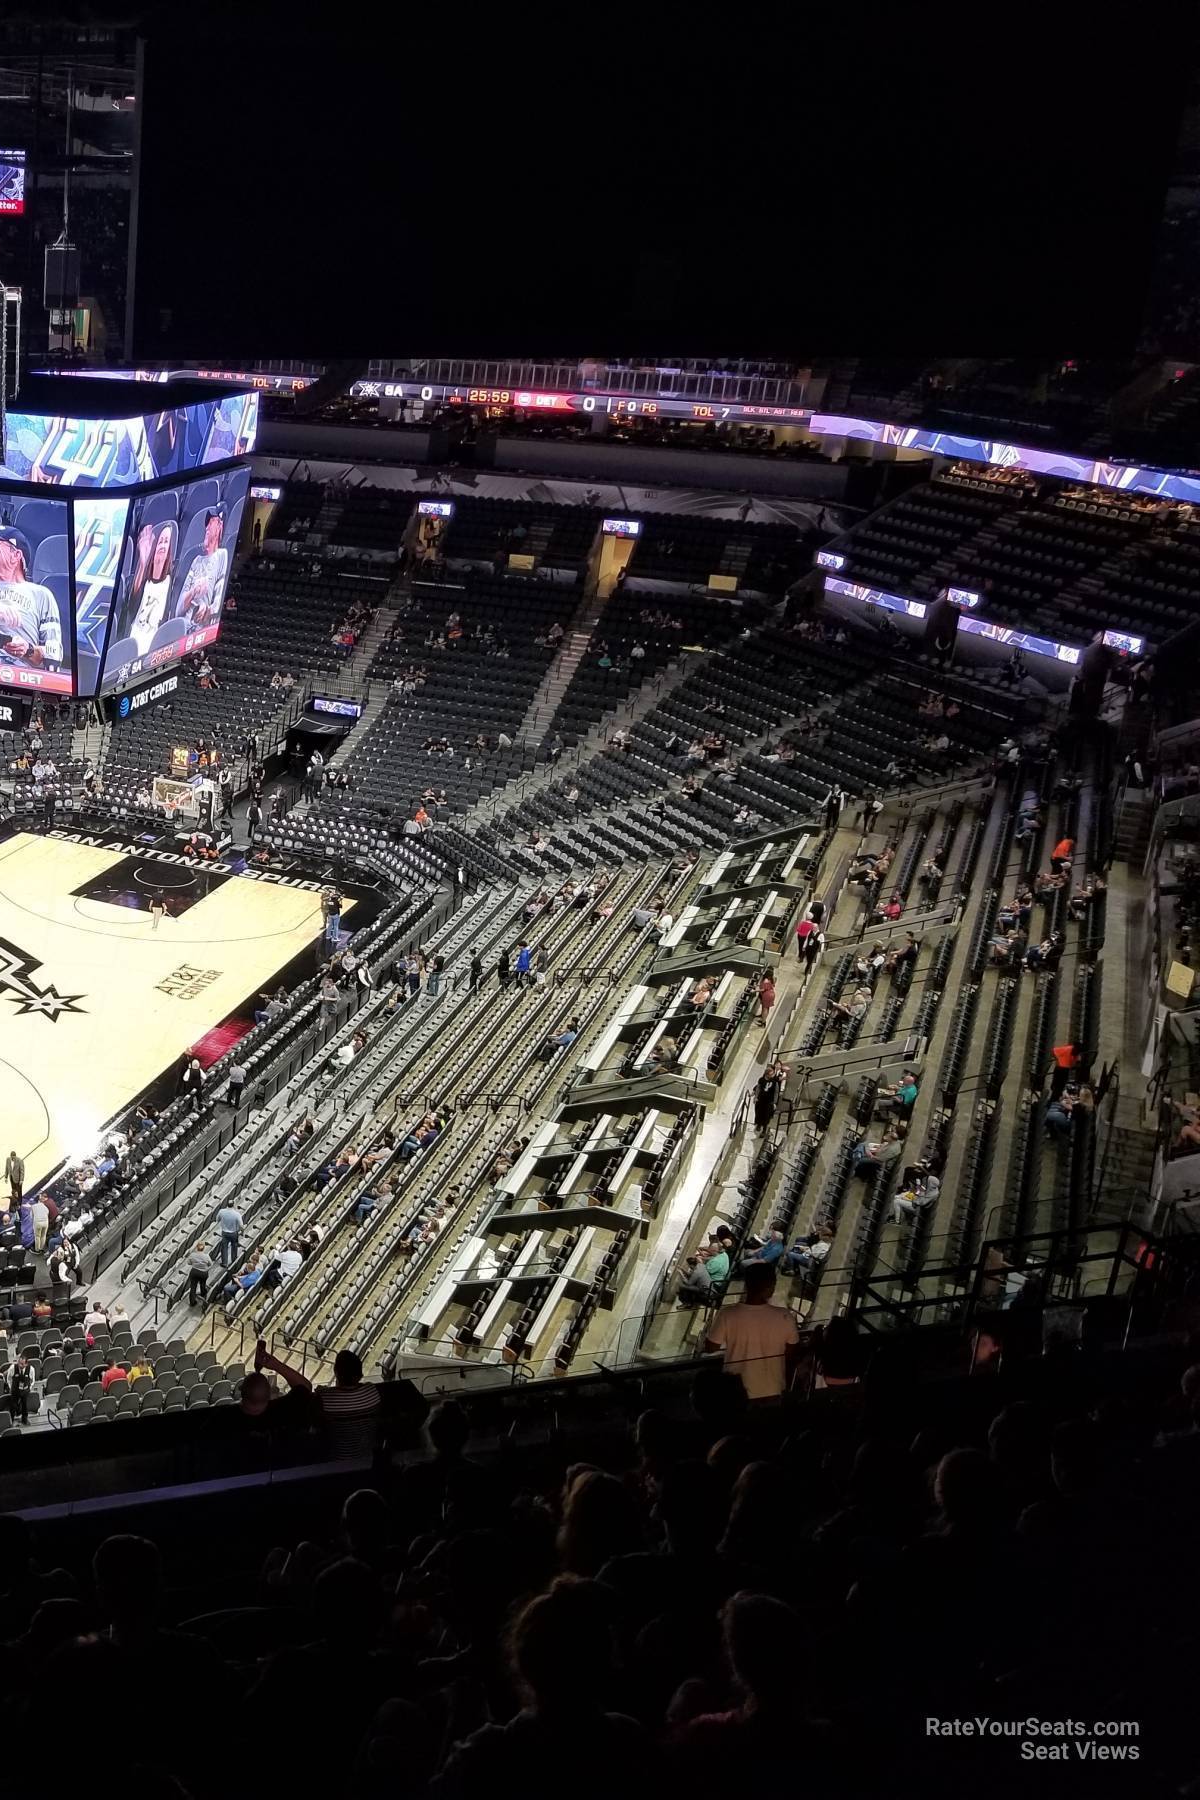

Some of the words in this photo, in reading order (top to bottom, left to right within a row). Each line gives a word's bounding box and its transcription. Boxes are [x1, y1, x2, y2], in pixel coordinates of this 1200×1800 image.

[252, 377, 269, 387] TOL
[275, 379, 282, 388] 7
[292, 380, 304, 390] FG
[384, 385, 402, 397] SA
[421, 387, 432, 400] 0
[453, 388, 459, 396] 1
[469, 391, 510, 403] 25:59
[536, 396, 559, 406] DET
[583, 397, 595, 411] 0
[618, 402, 626, 411] F
[627, 402, 636, 411] 0
[642, 403, 657, 412] FG
[693, 406, 714, 417] TOL
[722, 408, 730, 418] 7
[195, 632, 207, 645] DET
[151, 645, 174, 665] 25:59
[131, 660, 142, 674] SA
[20, 671, 43, 684] DET
[131, 689, 150, 710] AT&T
[150, 676, 178, 700] CENTER
[46, 829, 103, 849] SAN
[103, 842, 232, 873] ANTONIO
[153, 963, 204, 995] AT&T
[177, 969, 224, 1000] CENTER
